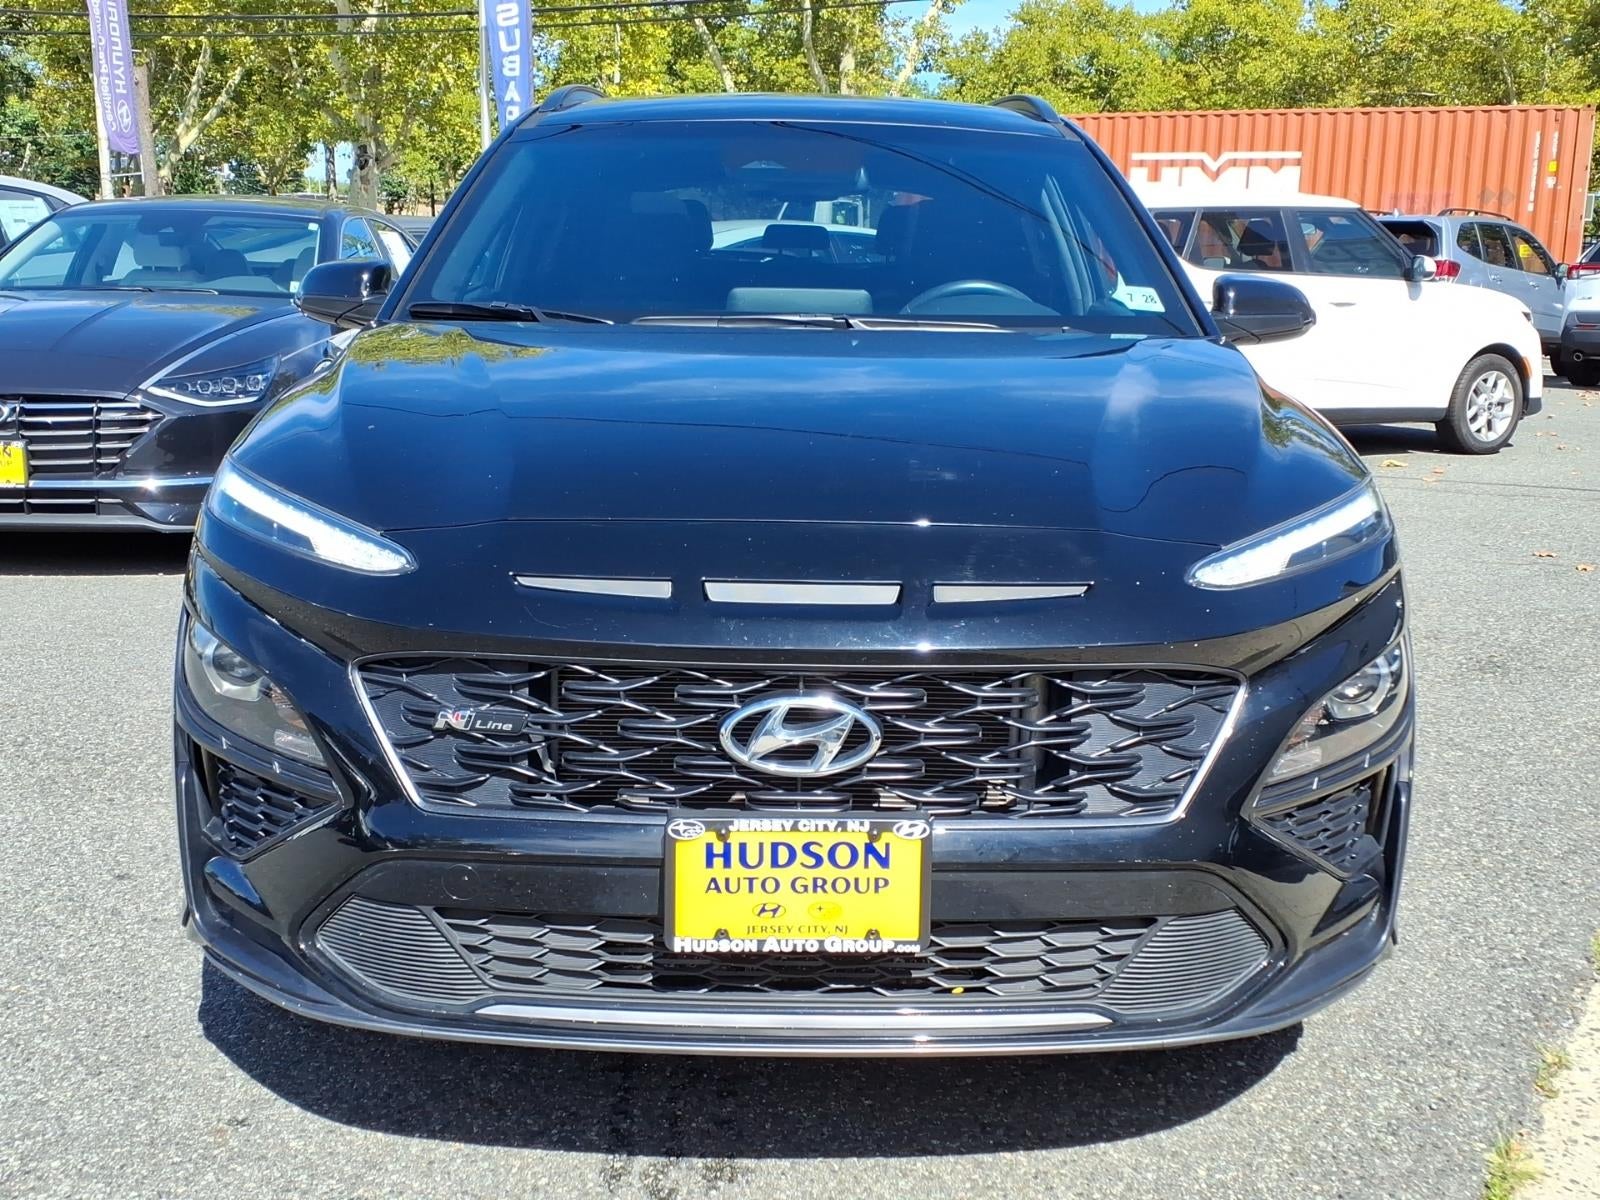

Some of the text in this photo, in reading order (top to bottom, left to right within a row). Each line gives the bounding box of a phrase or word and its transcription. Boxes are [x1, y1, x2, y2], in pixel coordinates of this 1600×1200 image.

[475, 719, 513, 731] Line
[728, 818, 870, 833] JERSEY CITY, NJ
[705, 841, 891, 869] HUDSON
[705, 876, 890, 894] AUTO GROUP
[746, 925, 794, 935] JERSEY
[834, 925, 849, 935] NJ
[673, 936, 759, 953] HUDSON
[762, 935, 817, 953] AUTO
